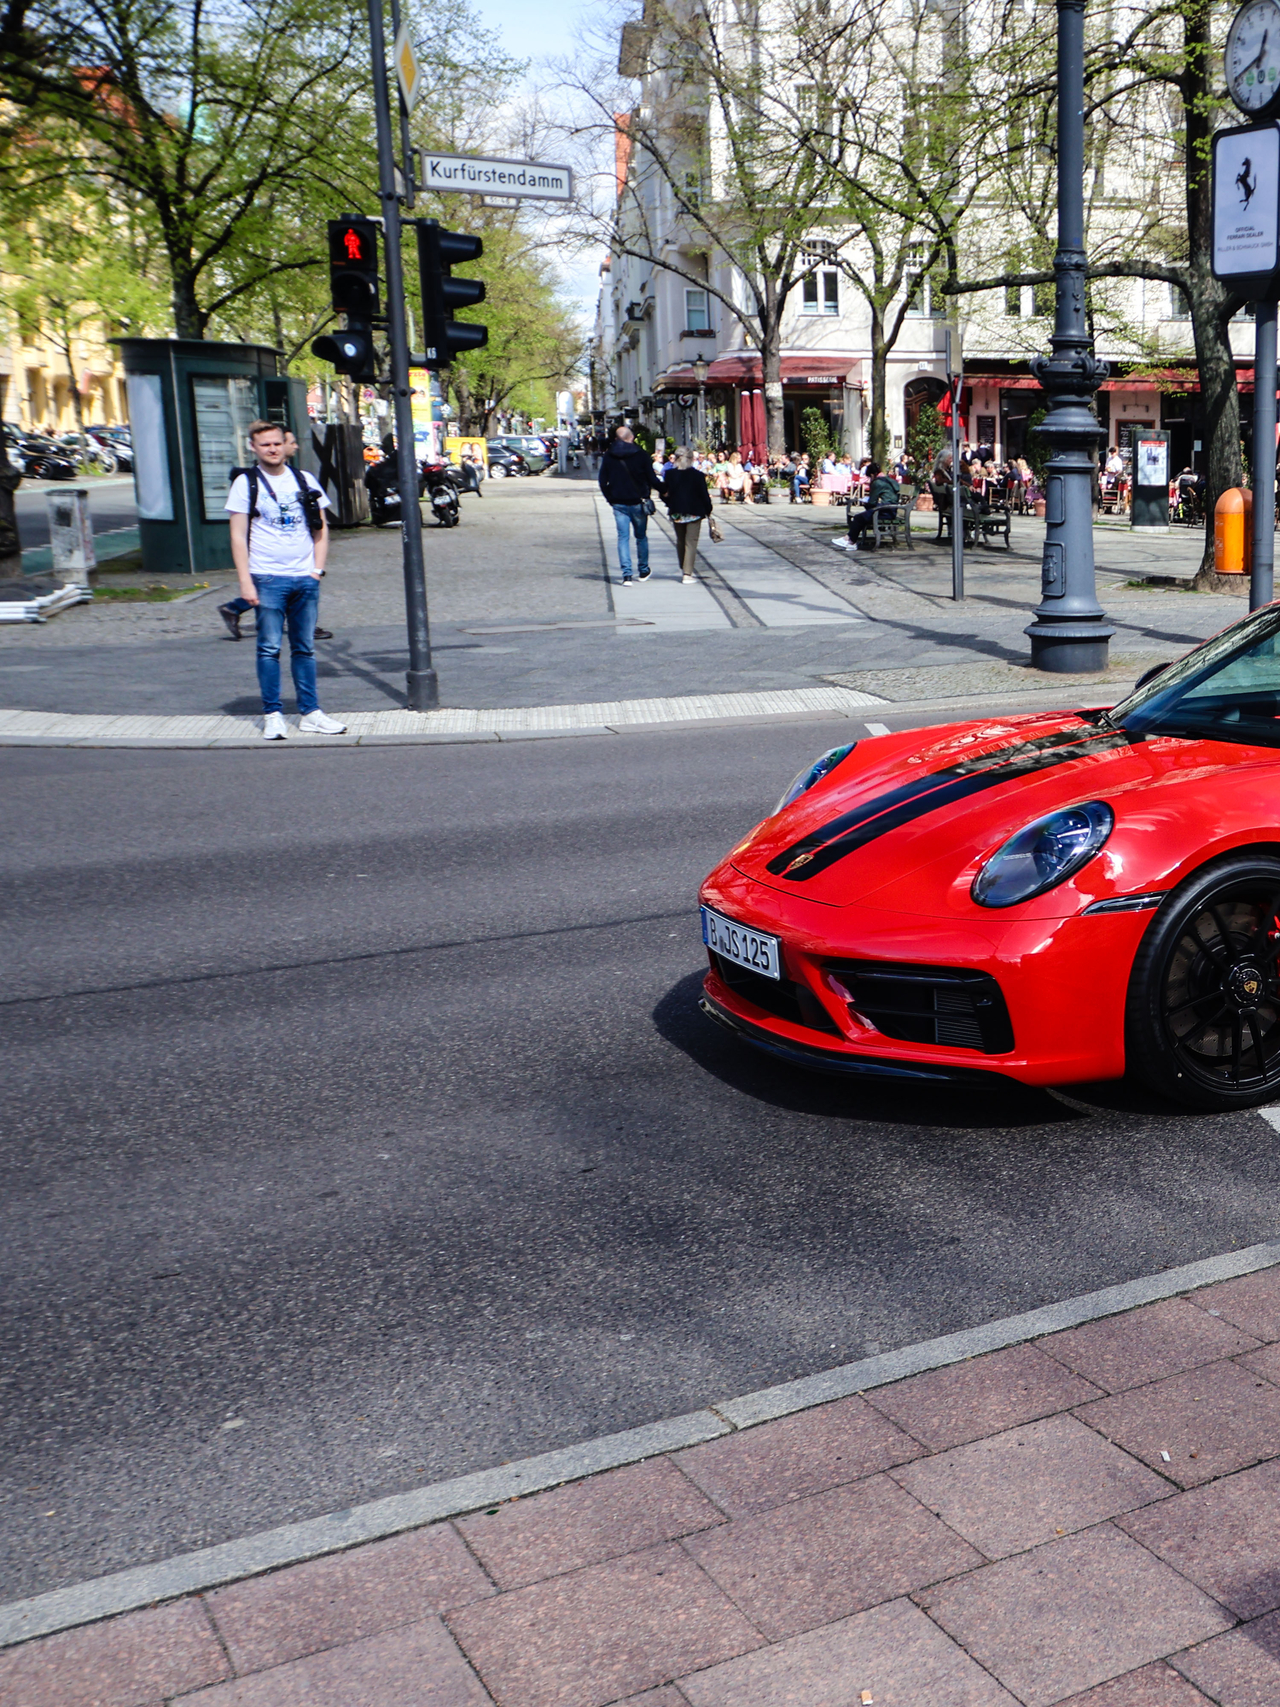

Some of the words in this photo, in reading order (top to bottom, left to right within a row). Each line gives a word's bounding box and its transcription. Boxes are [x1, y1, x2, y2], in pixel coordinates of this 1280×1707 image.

[430, 160, 563, 189] Kurfürstendamm
[709, 916, 718, 947] B
[724, 925, 740, 959] JS
[742, 933, 770, 971] 125
